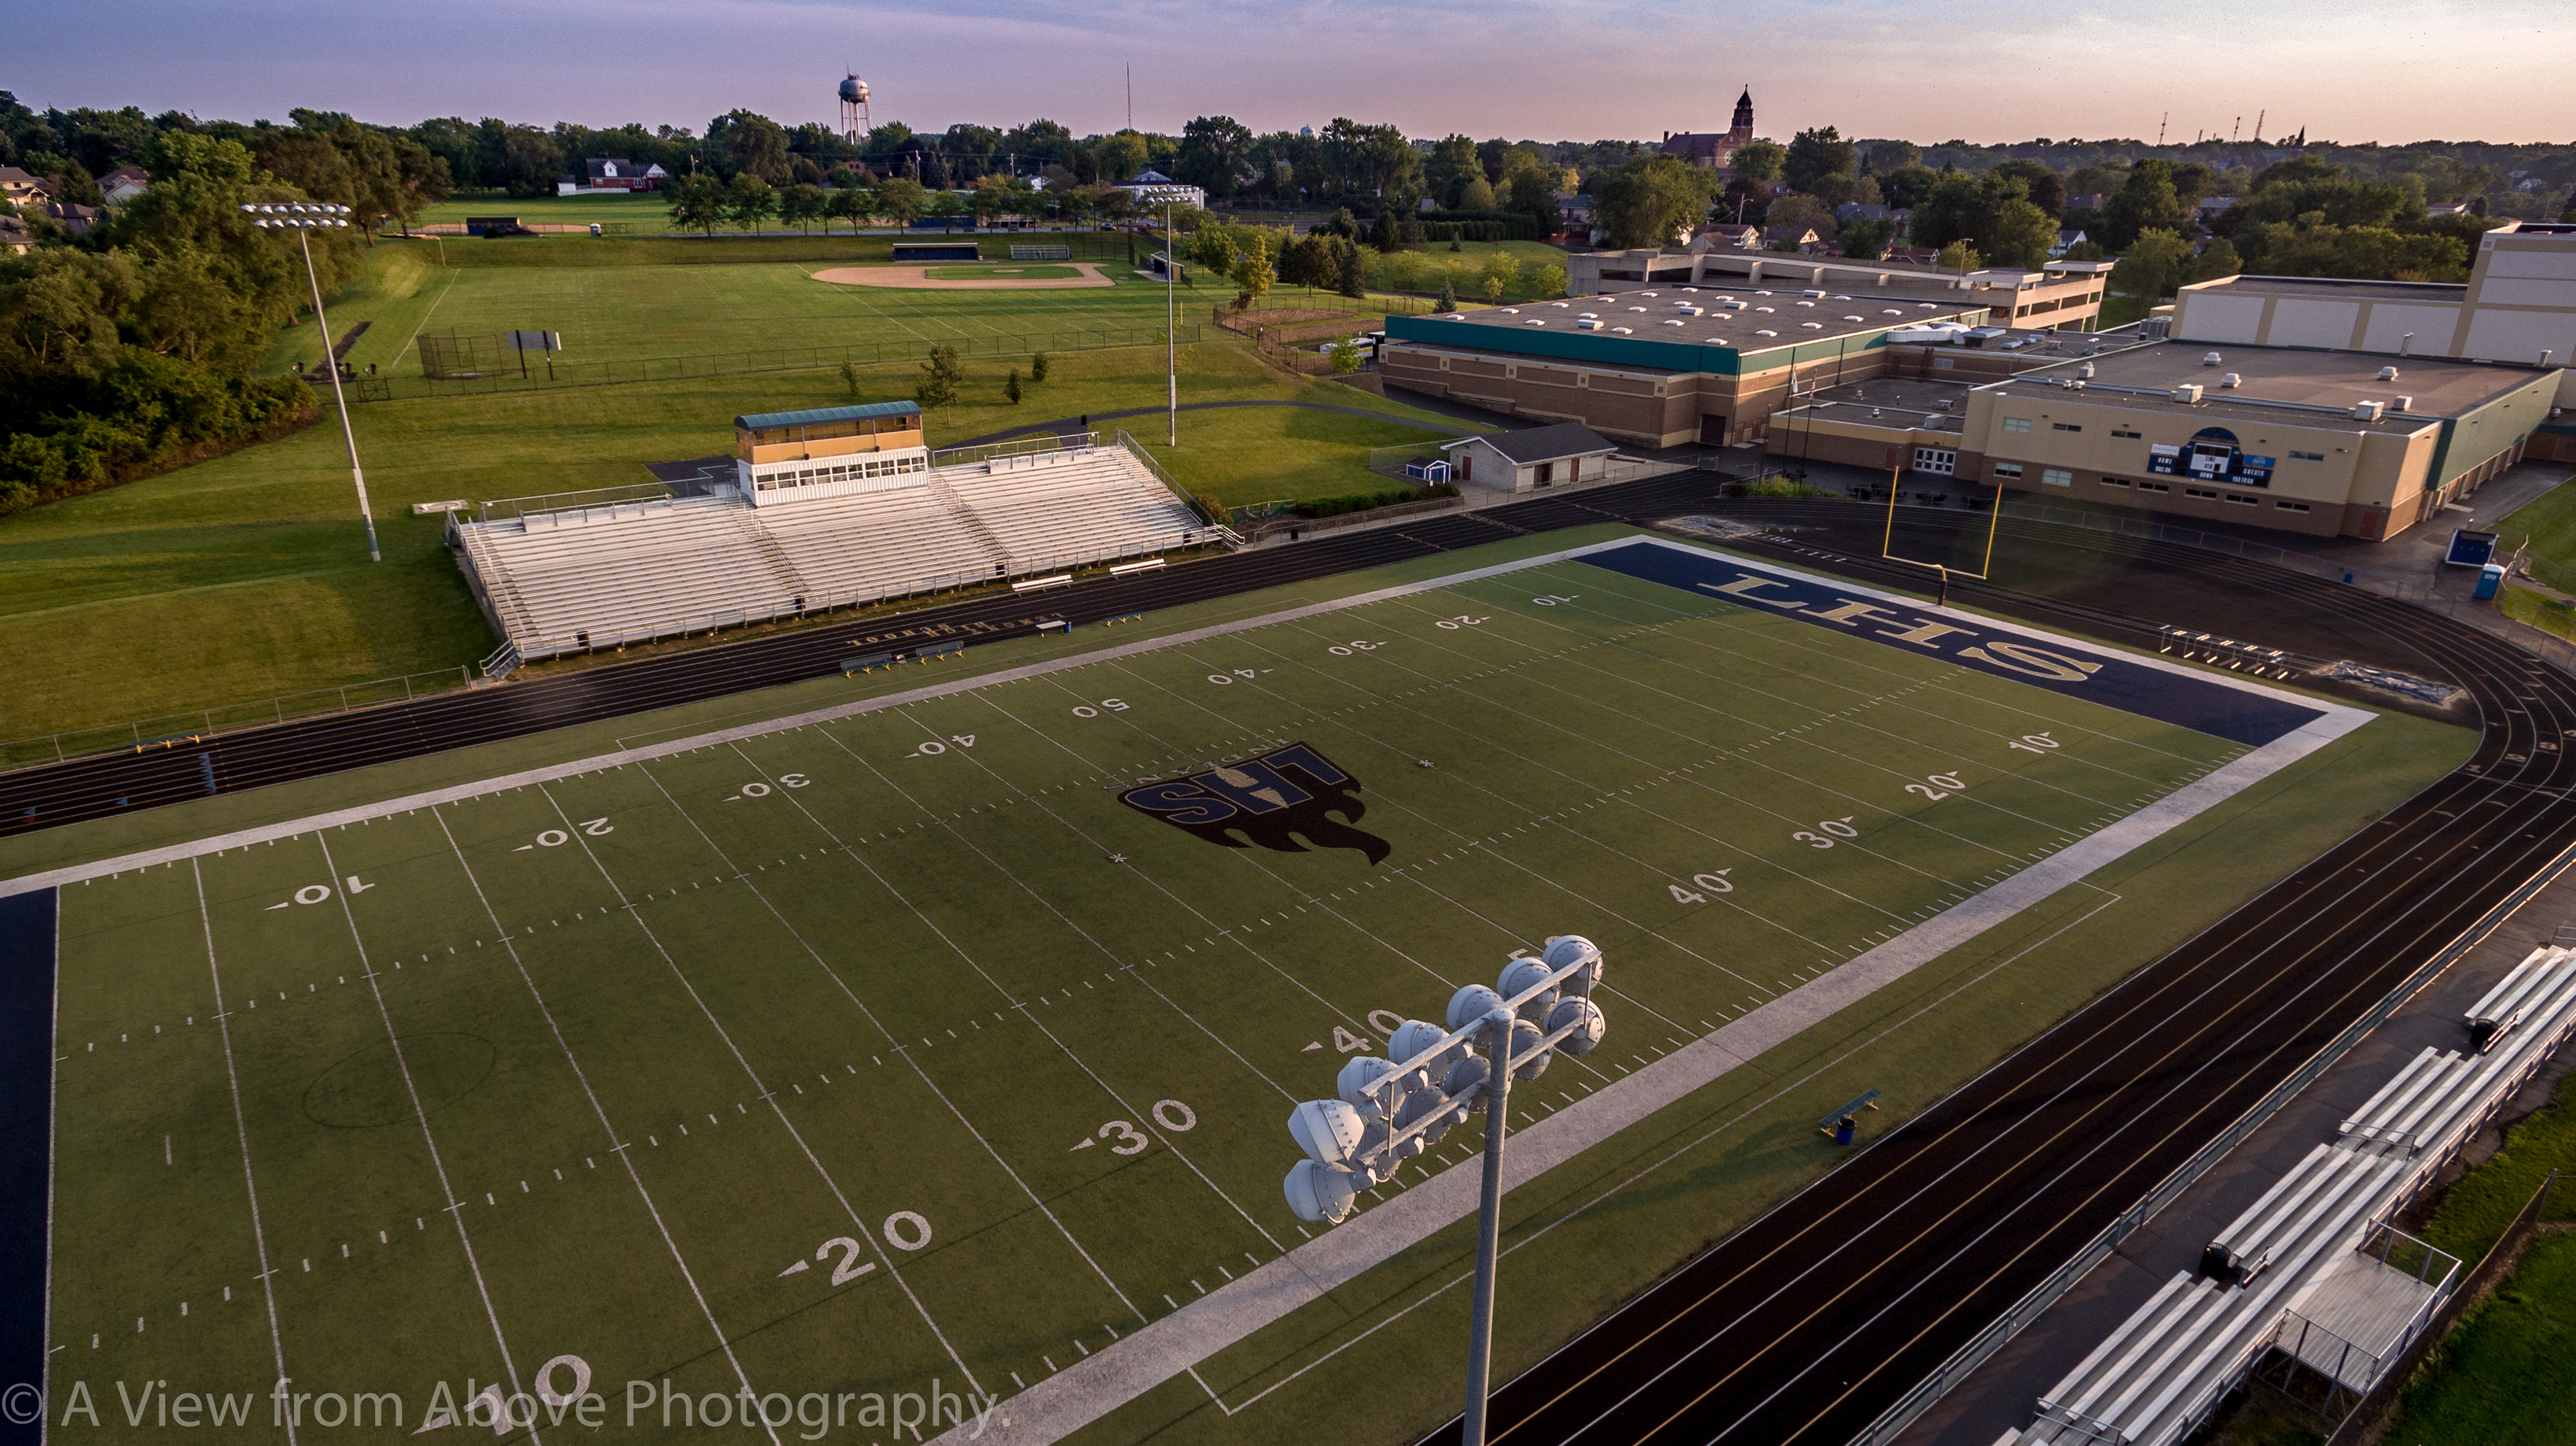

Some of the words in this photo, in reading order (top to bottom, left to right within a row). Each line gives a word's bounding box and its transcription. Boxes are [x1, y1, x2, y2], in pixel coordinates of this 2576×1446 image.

[1534, 595, 1569, 606] 10
[1436, 615, 1482, 630] 20
[1697, 573, 2104, 682] LHS
[1328, 640, 1377, 656] 30
[1208, 668, 1256, 685] 40
[1072, 698, 1130, 718] 50
[918, 734, 976, 755] 40
[2008, 734, 2059, 755] 10
[742, 773, 811, 797] 30
[1125, 744, 1348, 824] LHS
[1904, 774, 1966, 801] 20
[536, 817, 614, 847] 20
[1793, 820, 1859, 849] 30
[294, 875, 376, 905] 10
[1668, 873, 1734, 905] 40
[1333, 1009, 1407, 1054] 40
[1098, 1099, 1197, 1156] 30
[816, 1211, 933, 1287] 20
[463, 1354, 592, 1437] 10
